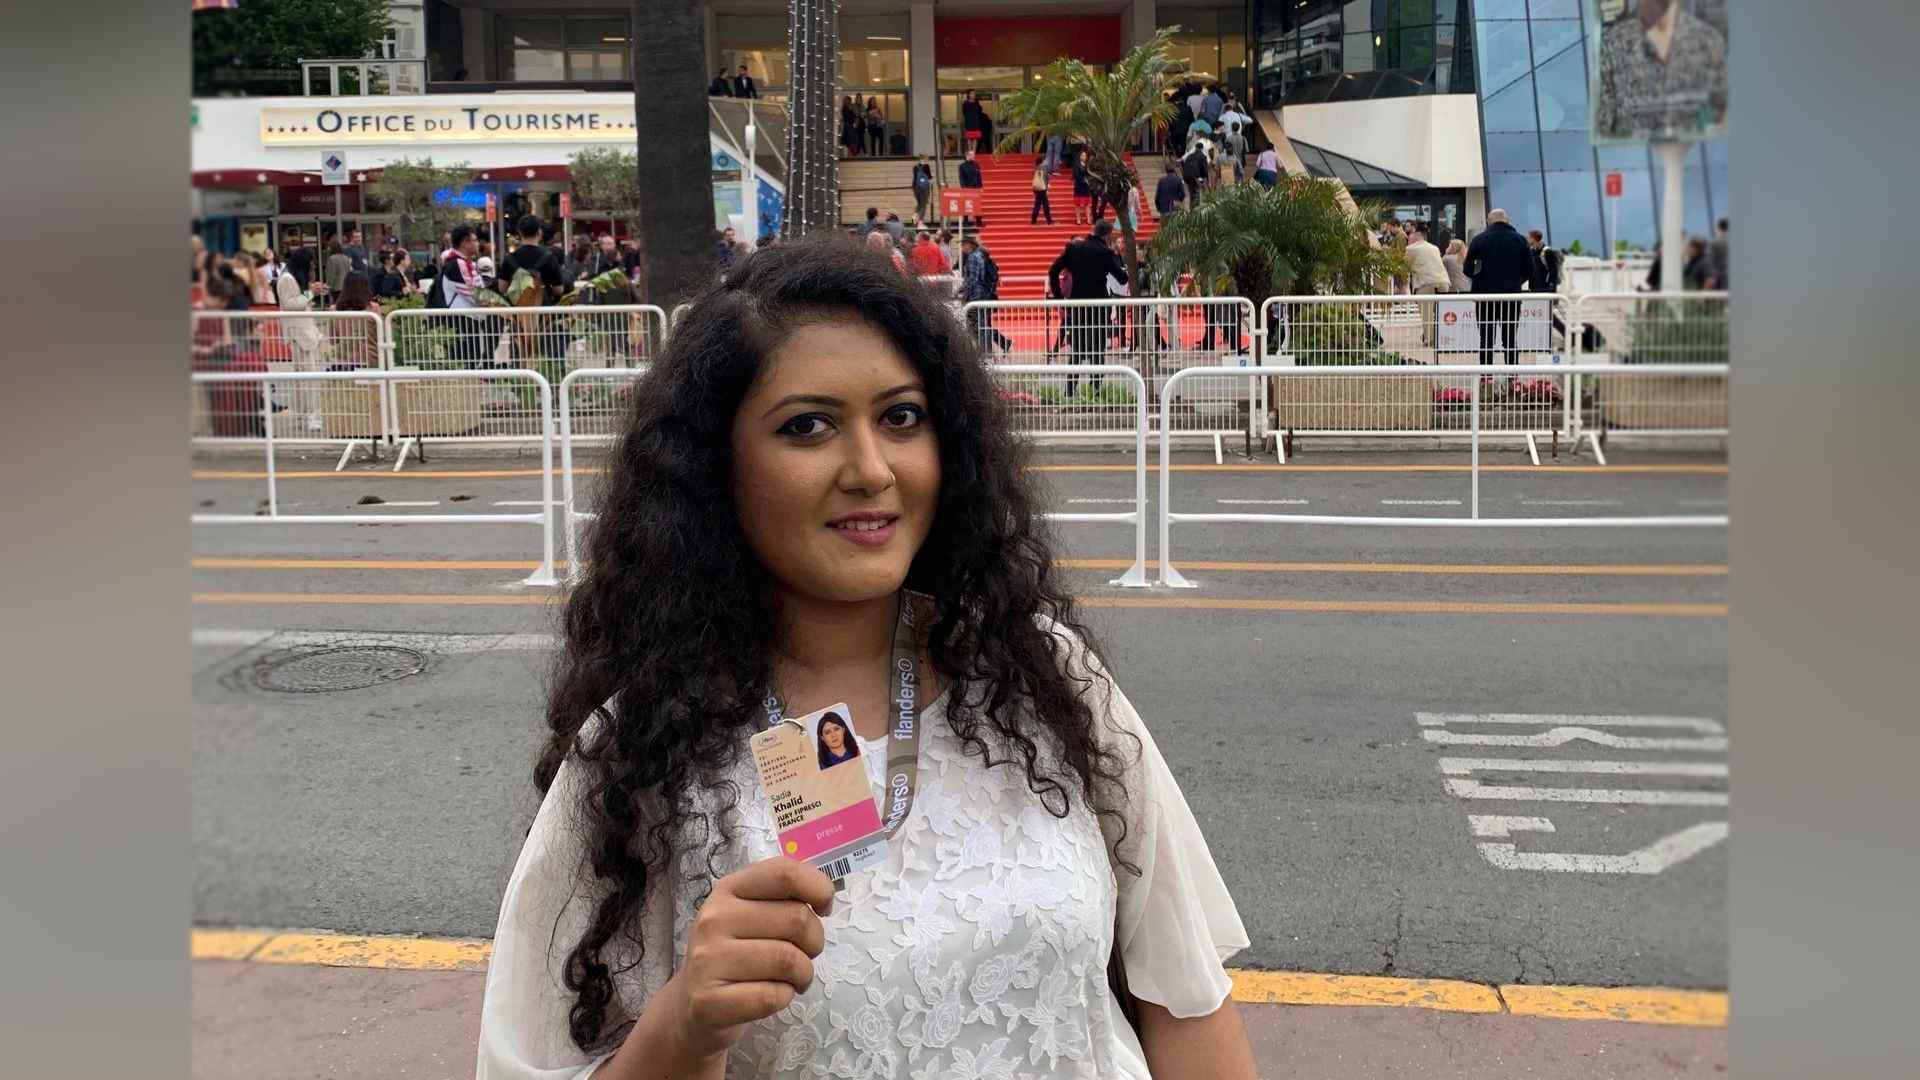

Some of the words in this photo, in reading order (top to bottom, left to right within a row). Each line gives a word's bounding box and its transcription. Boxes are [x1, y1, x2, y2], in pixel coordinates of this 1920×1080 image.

[771, 790, 792, 803] Sadia
[774, 795, 803, 813] Khalid
[778, 812, 793, 823] JURY
[794, 800, 822, 816] FIPRESCI
[779, 815, 804, 829] FRANCE
